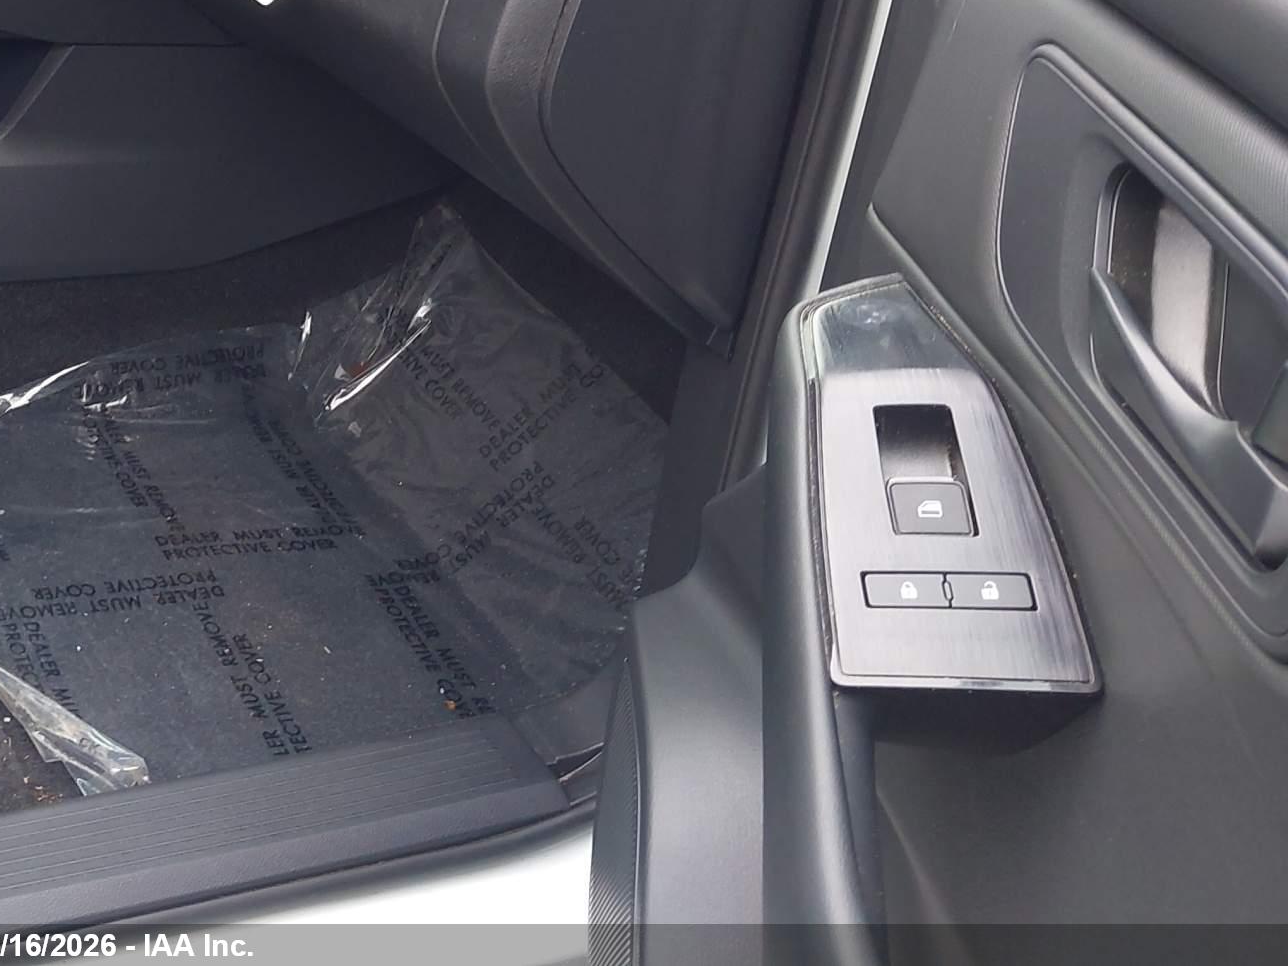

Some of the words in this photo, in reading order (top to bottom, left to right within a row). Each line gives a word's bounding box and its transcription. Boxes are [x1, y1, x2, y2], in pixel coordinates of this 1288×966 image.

[489, 388, 577, 472] PROTECTIVE
[155, 531, 219, 547] DEALER
[233, 528, 282, 541] MUST
[162, 540, 272, 561] PROTECTIVE
[32, 583, 97, 600] COVER
[90, 595, 142, 614] MUST
[103, 570, 217, 595] PROTECTIVE
[153, 585, 225, 606] DEALER
[24, 621, 61, 677] DEALER
[192, 601, 239, 666] REMOVE
[374, 587, 442, 673] PROTECTIVE
[394, 585, 440, 639] DEALER
[435, 648, 477, 688] MUST
[231, 634, 273, 685] COVER
[230, 675, 270, 719] MUST
